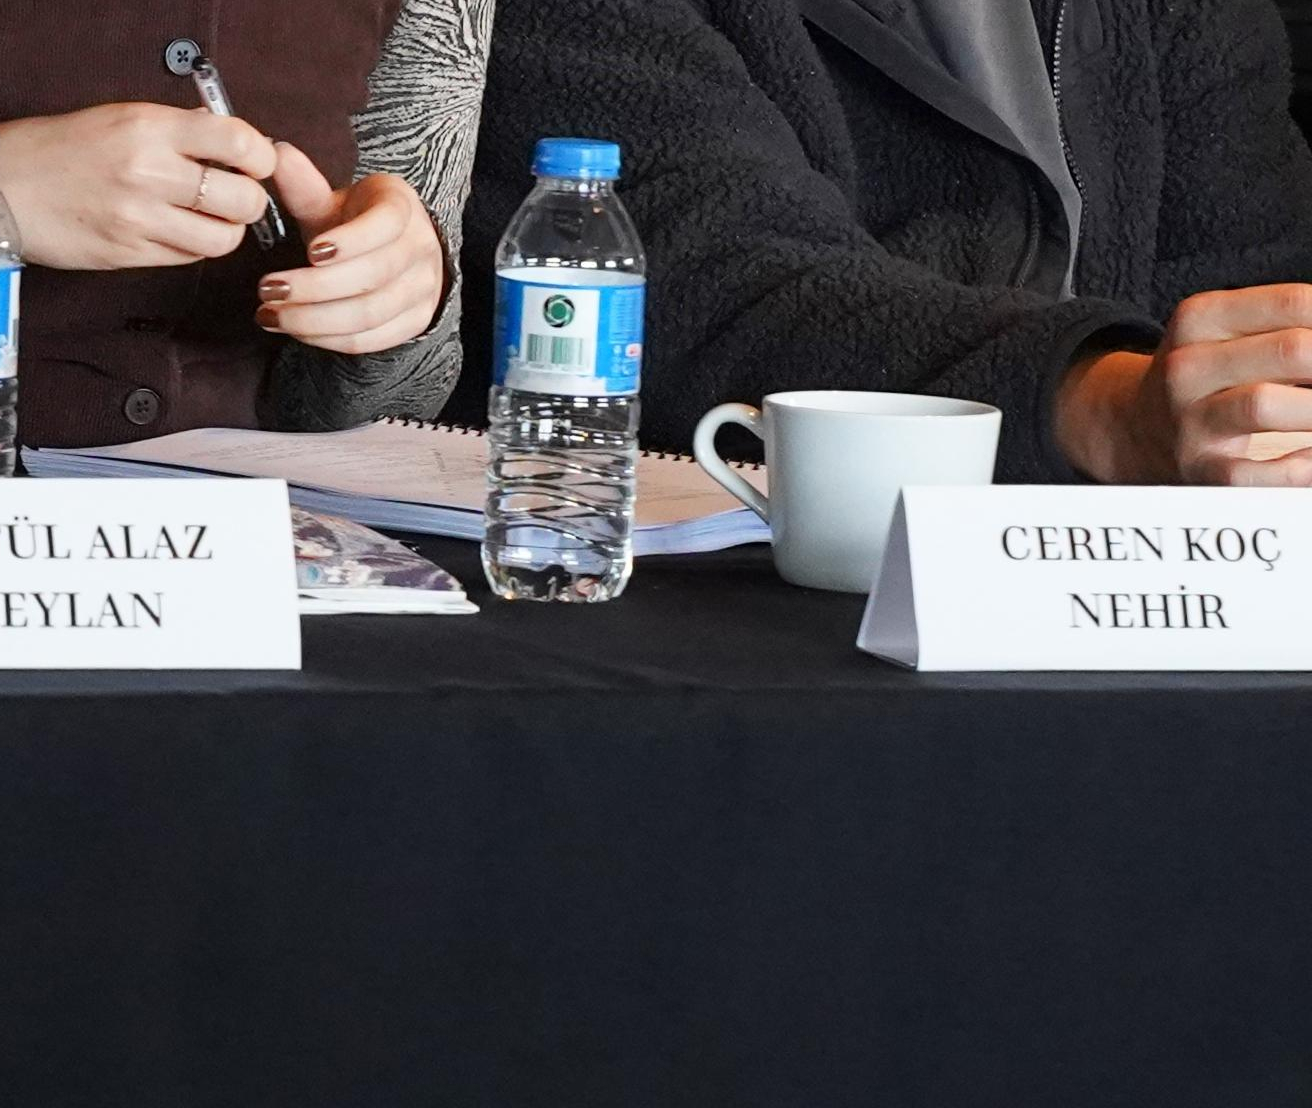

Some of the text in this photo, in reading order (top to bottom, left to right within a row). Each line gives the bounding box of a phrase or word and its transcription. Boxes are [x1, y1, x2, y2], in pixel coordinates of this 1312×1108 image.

[86, 523, 214, 561] ALAZ
[1000, 525, 1282, 573] CEREN KOÇ
[1067, 584, 1231, 631] NEHİR
